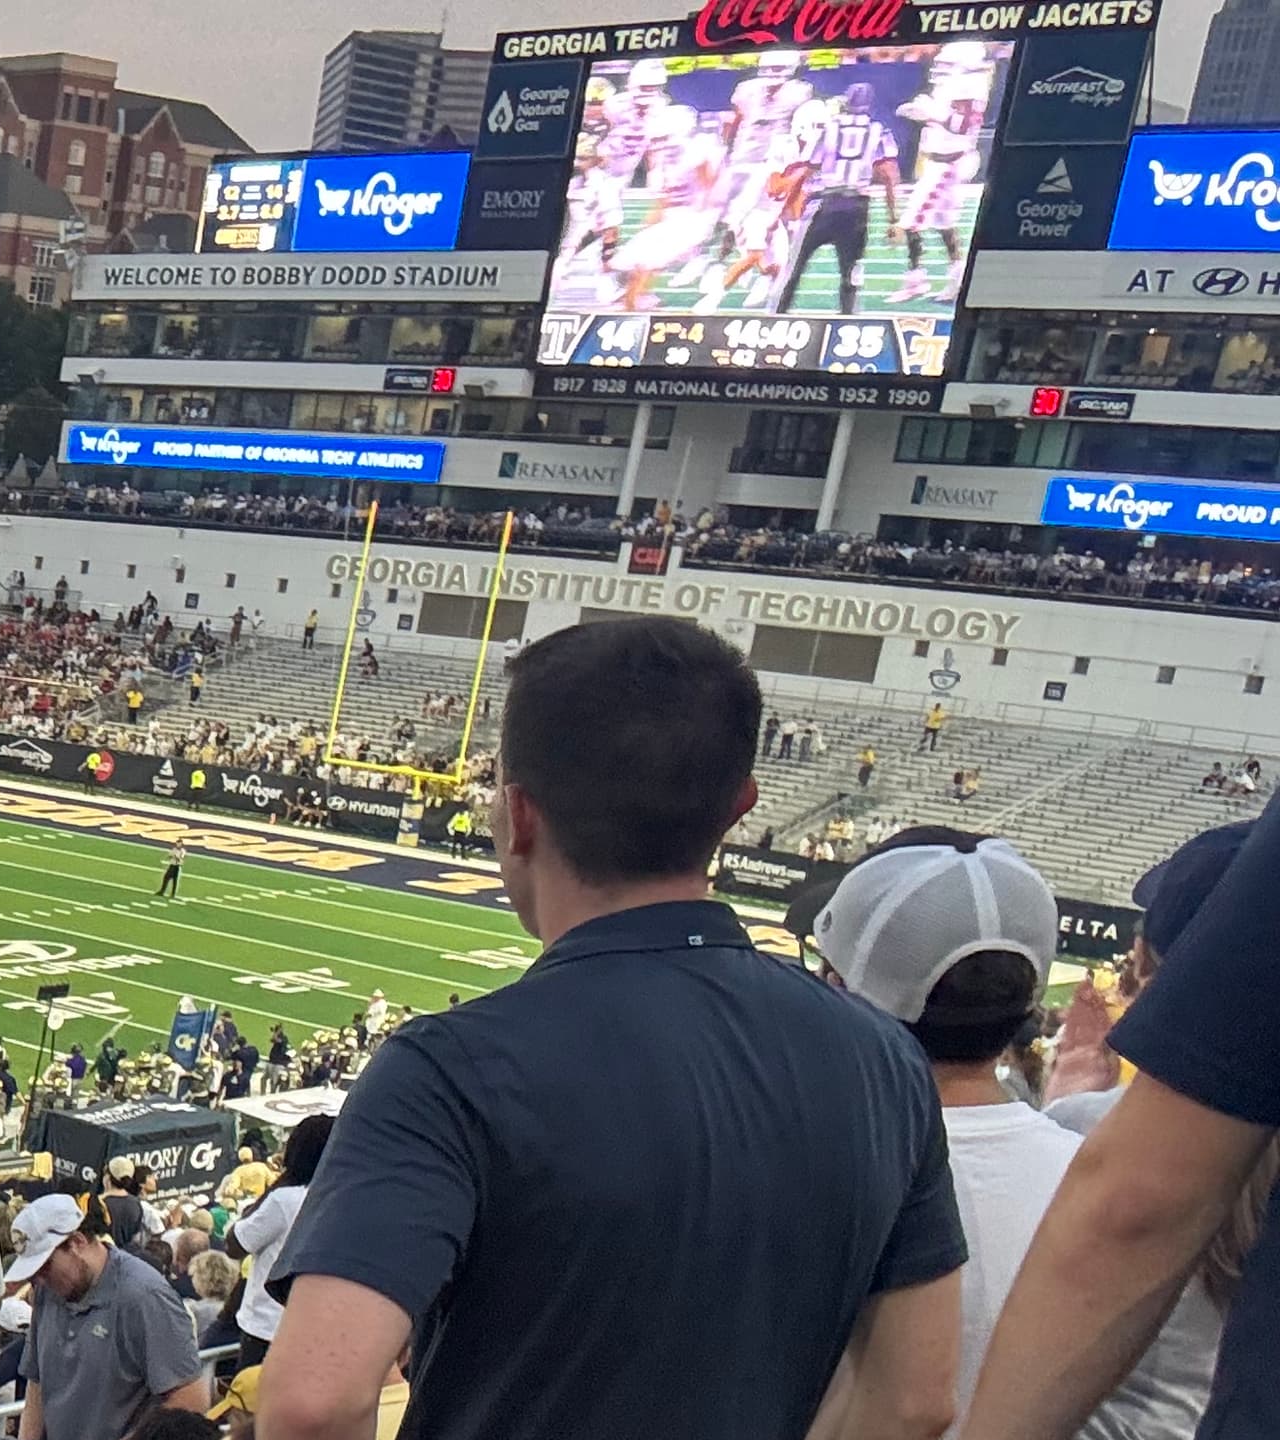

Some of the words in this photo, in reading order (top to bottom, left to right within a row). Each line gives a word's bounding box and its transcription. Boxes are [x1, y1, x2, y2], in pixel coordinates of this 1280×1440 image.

[918, 5, 1025, 33] YELLOW
[1029, 1, 1152, 29] JACKETS
[504, 32, 606, 58] GEORGIA
[614, 26, 679, 51] TECH
[519, 86, 570, 101] Georgia
[1028, 80, 1104, 94] SOUTHEAST
[517, 103, 565, 116] Natural
[514, 118, 539, 131] Gas
[351, 171, 442, 235] Kroger
[482, 190, 544, 208] EMORY
[1017, 200, 1083, 219] Georgia
[1018, 220, 1072, 237] Power
[104, 265, 202, 287] WELCOME
[209, 266, 236, 287] TO
[242, 266, 315, 287] BOBBY
[321, 265, 386, 287] DODD
[392, 265, 499, 287] STADIUM
[1126, 269, 1175, 293] AT
[596, 320, 636, 351] 14
[724, 319, 811, 349] 14:40
[833, 325, 885, 358] 35
[553, 377, 584, 392] 1917
[592, 378, 626, 394] 1928
[635, 379, 720, 398] NATIONAL
[724, 383, 828, 401] CHAMPIONS
[840, 387, 877, 404] 1952
[887, 389, 931, 406] 1990
[152, 442, 192, 457] PROUD
[194, 443, 244, 460] PARTNER
[245, 444, 262, 460] OF
[264, 446, 319, 464] GEORGIA
[322, 449, 353, 466] TECH
[357, 452, 425, 471] ATHLETICS
[518, 461, 619, 483] RENASANT
[925, 487, 998, 507] RENASANT
[1097, 483, 1173, 530] Kroger
[1196, 503, 1267, 524] PROUD
[326, 554, 467, 592] GEORGIA
[478, 565, 665, 609] INSTITUTE
[674, 584, 725, 614] OF
[738, 590, 1020, 645] TECHNOLOGY
[239, 774, 284, 808] Kroger
[348, 801, 401, 819] HYUNDAI
[1059, 915, 1119, 940] ELTA
[189, 1141, 223, 1172] GT
